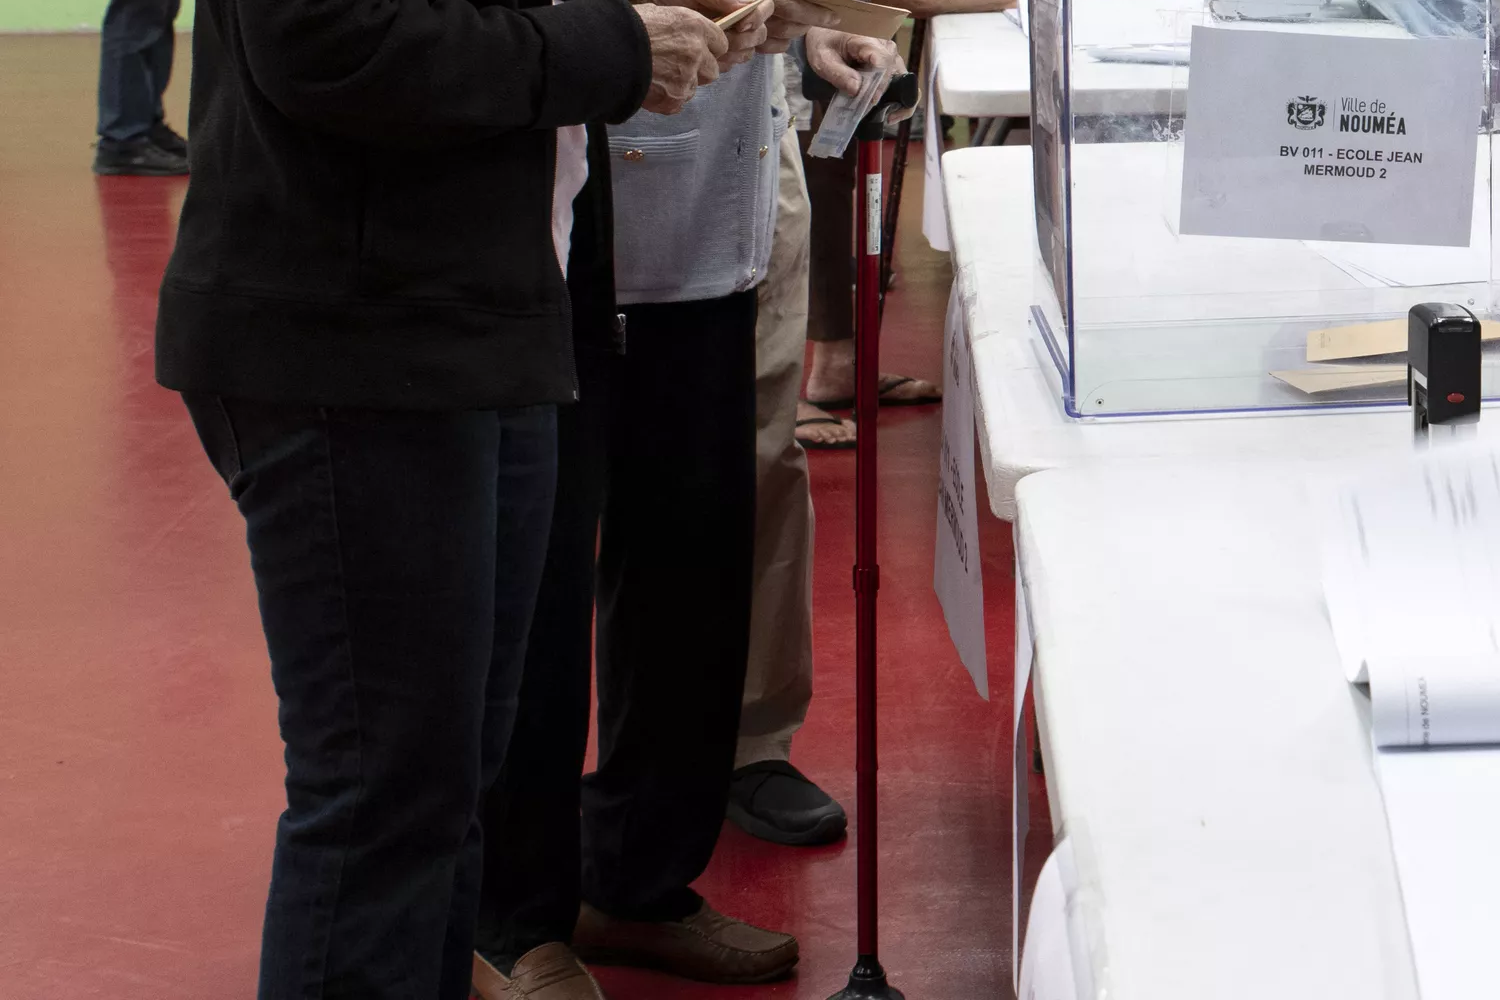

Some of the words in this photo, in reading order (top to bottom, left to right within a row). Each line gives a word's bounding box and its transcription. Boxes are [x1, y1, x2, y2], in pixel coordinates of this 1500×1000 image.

[1341, 97, 1366, 113] Ville
[1370, 99, 1386, 114] de
[1340, 111, 1407, 135] NOUMÉA
[1280, 145, 1299, 157] BV
[1302, 147, 1323, 159] 011
[1337, 149, 1383, 161] ECOLE
[1387, 151, 1423, 163] JEAN
[1304, 164, 1376, 178] MERMOUD
[1379, 168, 1387, 179] 2
